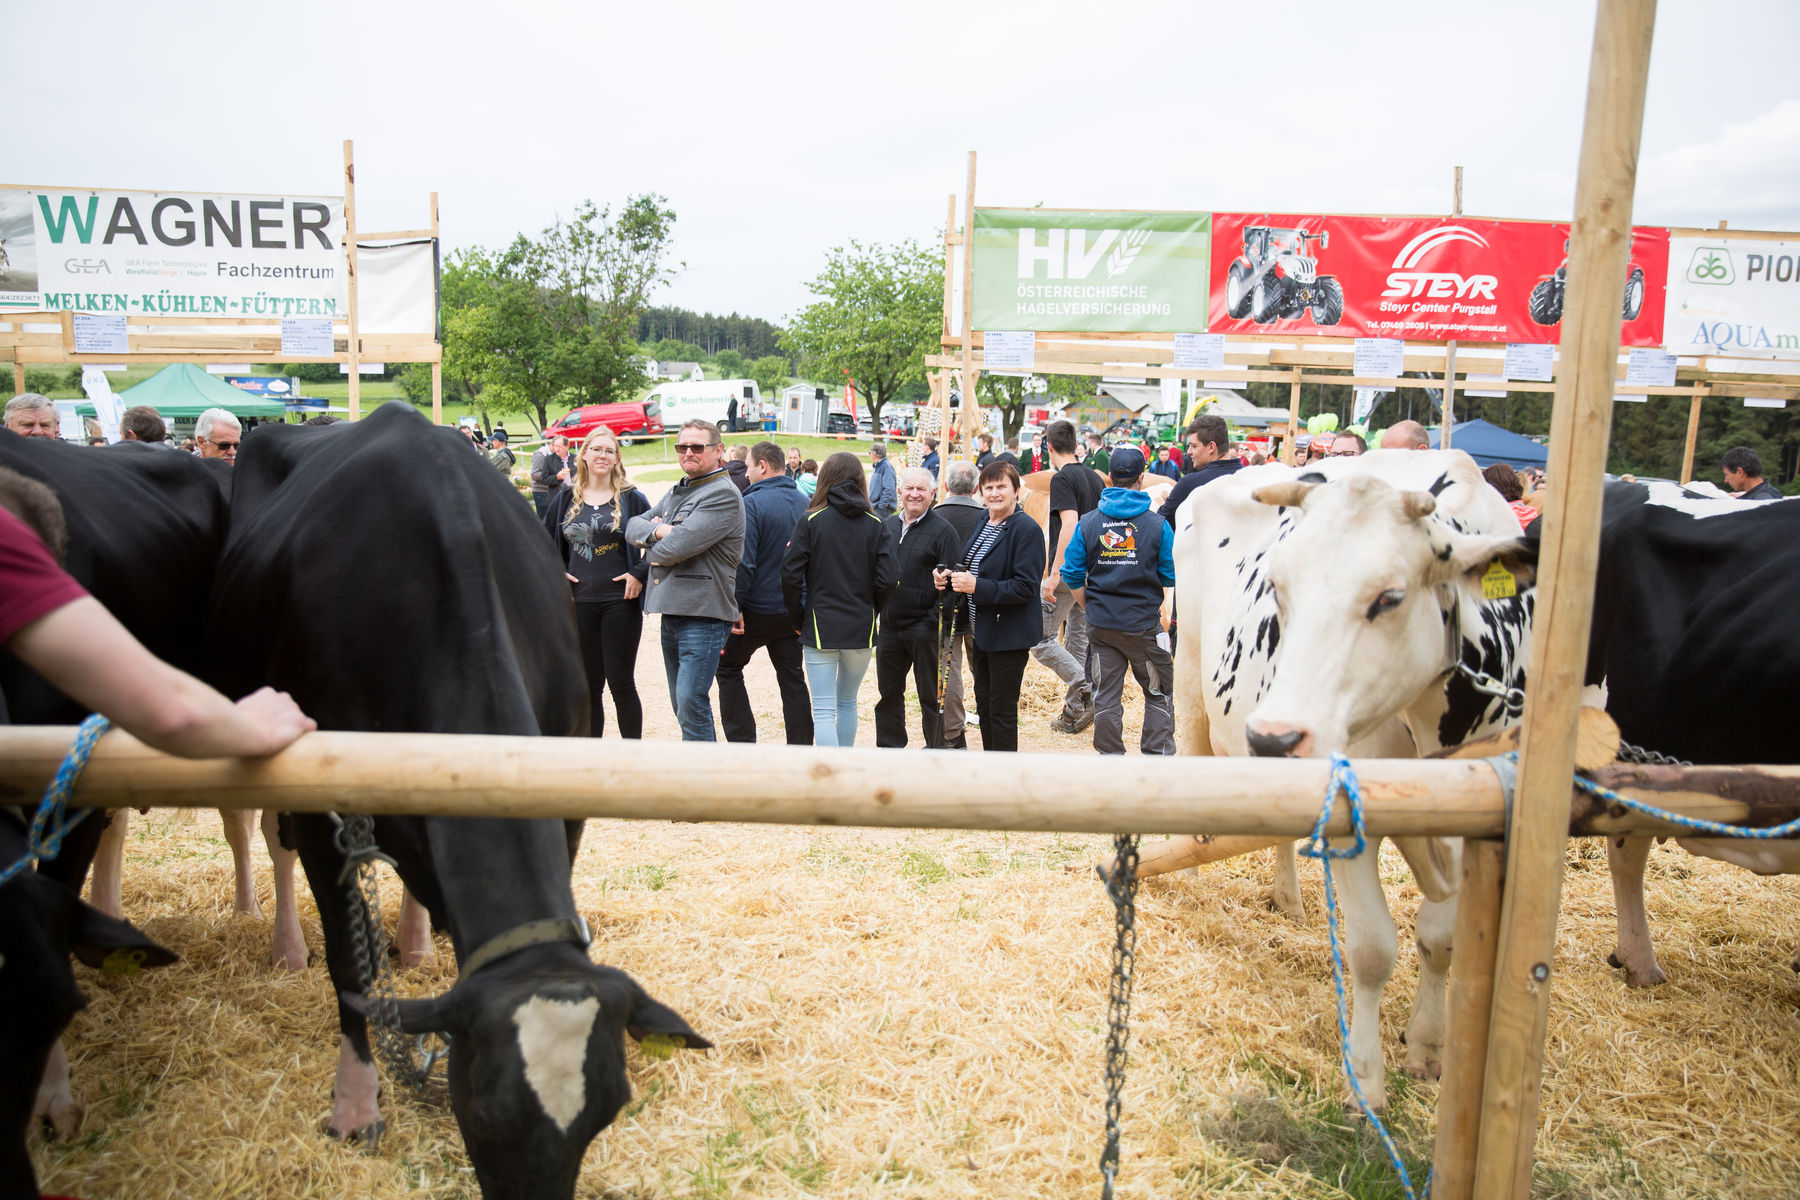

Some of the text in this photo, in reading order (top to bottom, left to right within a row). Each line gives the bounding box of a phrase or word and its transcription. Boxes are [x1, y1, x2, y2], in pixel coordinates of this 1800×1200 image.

[37, 194, 334, 251] WAGNER
[1017, 227, 1121, 279] HV
[64, 258, 112, 274] GEA
[217, 262, 334, 279] Fachzentrum
[1746, 254, 1800, 282] PIO
[1017, 282, 1147, 298] ÖSTERREICHISCHE
[1381, 272, 1498, 300] STEYR
[1017, 302, 1172, 315] HAGELVERSICHERUNG
[1379, 301, 1497, 316] Steyr Center Purgstall
[1366, 321, 1379, 329] Tel.
